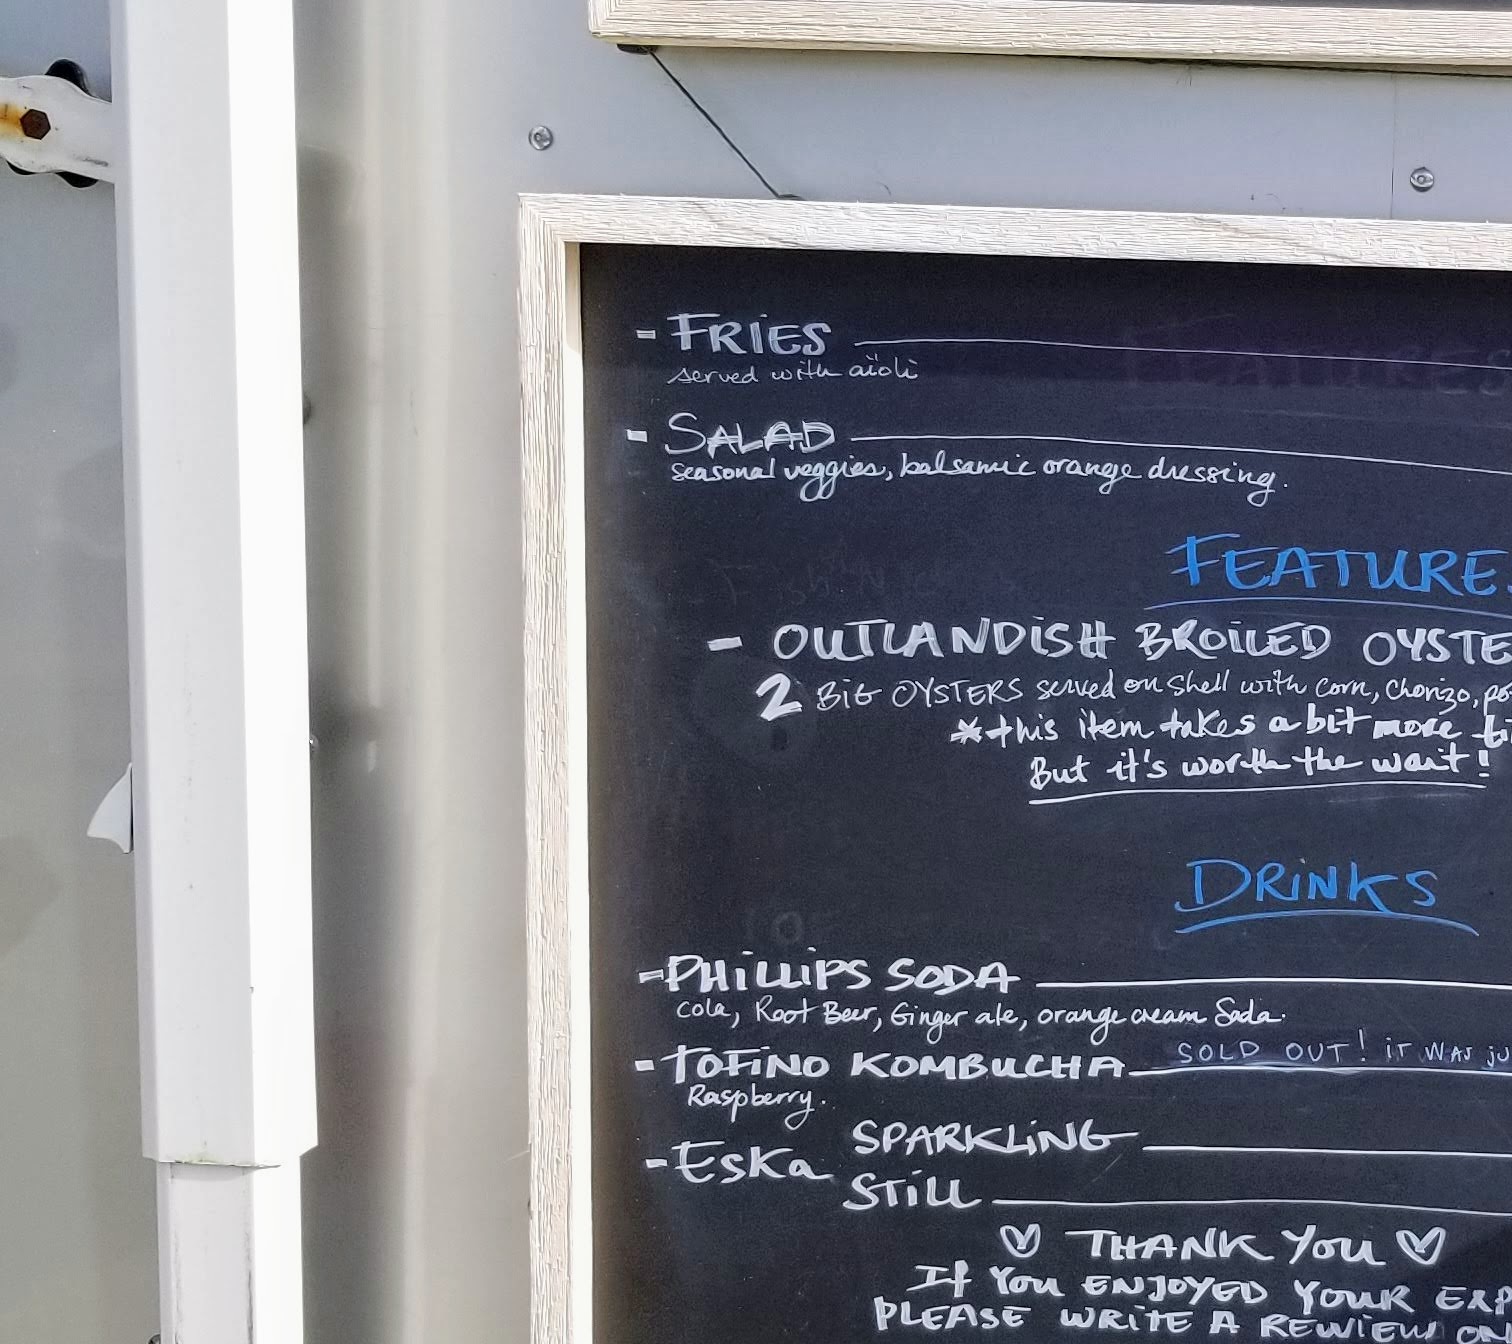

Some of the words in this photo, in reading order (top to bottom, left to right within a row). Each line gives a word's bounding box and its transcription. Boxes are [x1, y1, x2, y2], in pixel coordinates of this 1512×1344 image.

[671, 312, 833, 355] FRIES
[667, 363, 759, 386] served
[772, 360, 842, 382] with
[665, 413, 835, 455] SALAD
[671, 460, 776, 481] seasonal
[900, 451, 1036, 476] balsamic
[1043, 457, 1142, 494] orange
[772, 617, 1116, 662] OUTLANDISH
[1136, 619, 1331, 661] BROILED
[756, 673, 803, 721] 2
[892, 677, 1025, 708] OYSTERS
[1037, 670, 1116, 700] served
[1124, 676, 1163, 694] on
[1240, 669, 1308, 694] with
[1078, 708, 1154, 740] item
[1269, 717, 1302, 733] a
[1306, 703, 1372, 736] bit
[1373, 715, 1462, 740] more
[1029, 756, 1090, 790] But
[1107, 750, 1168, 782] it's
[1182, 751, 1292, 776] worth
[1292, 746, 1363, 776] the
[1174, 858, 1438, 913] DRINKS
[663, 947, 871, 993] PHILLIPS
[884, 956, 1022, 995] SODA
[756, 995, 819, 1024] Root
[1037, 1007, 1129, 1044] orange
[1131, 1007, 1208, 1024] cream
[660, 1044, 830, 1084] TOFINO
[851, 1052, 1131, 1081] KOMBUCHA
[1177, 1040, 1260, 1064] SOLD
[851, 1119, 1139, 1156] SPARKLING
[843, 1169, 982, 1211] STILL
[1065, 1226, 1275, 1262] THANK
[1081, 1275, 1268, 1304] ENJOYED
[875, 1297, 1031, 1331] PLEASE
[1060, 1305, 1193, 1333] WRITE
[1209, 1311, 1240, 1333] A
